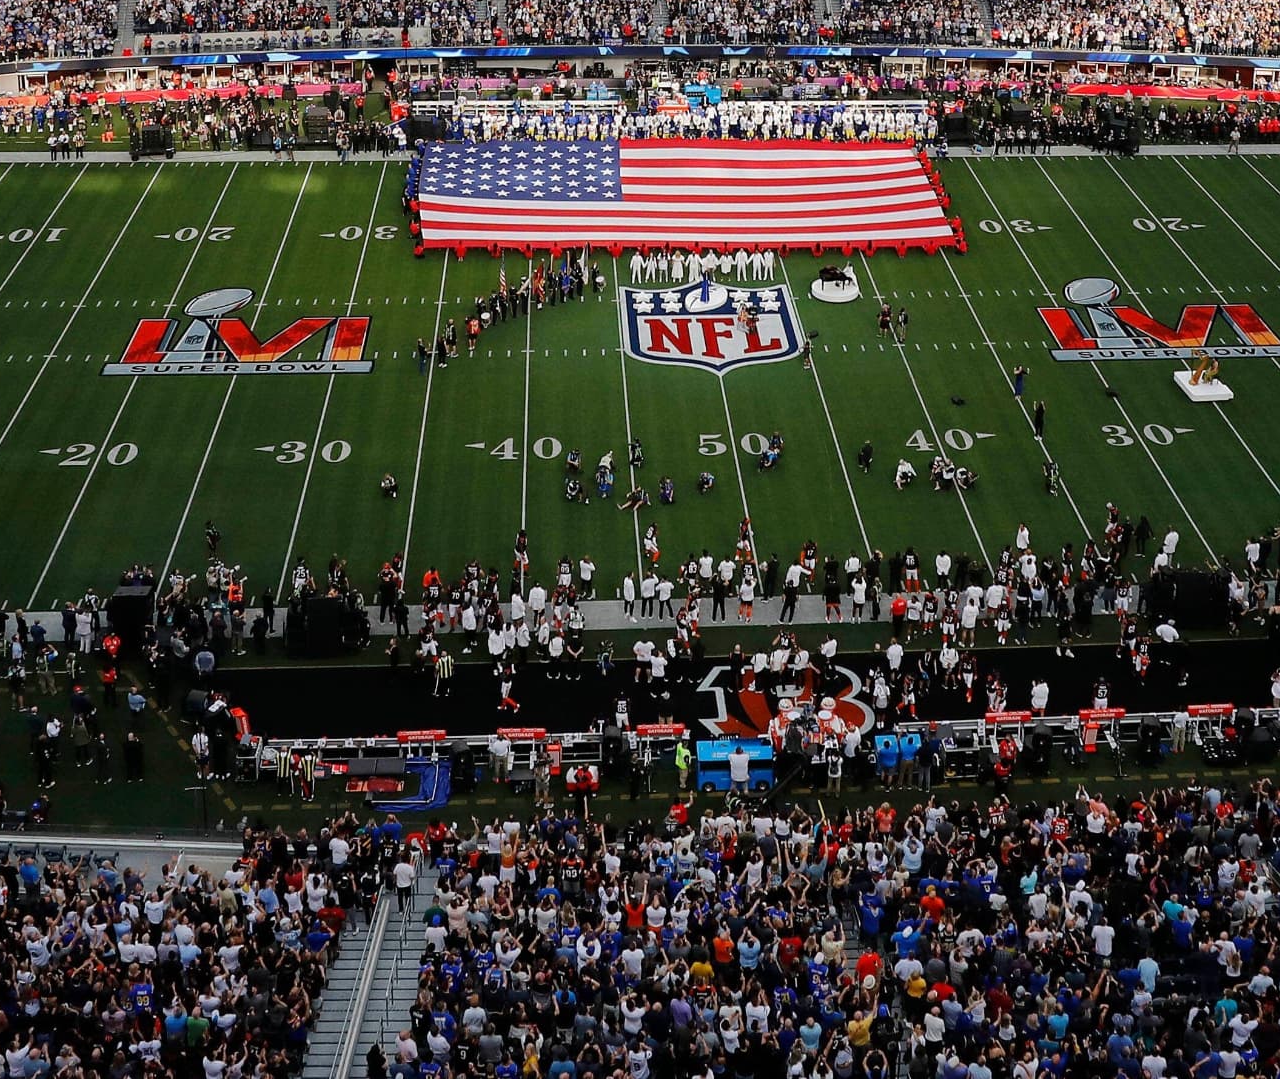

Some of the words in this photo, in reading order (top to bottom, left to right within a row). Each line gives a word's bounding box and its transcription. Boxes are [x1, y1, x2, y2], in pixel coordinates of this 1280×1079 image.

[644, 317, 783, 359] NFL
[1077, 349, 1179, 360] SUPER
[129, 364, 240, 373] SUPER
[255, 363, 346, 373] BOWL
[697, 433, 770, 457] 50
[904, 428, 975, 452] 40
[1101, 423, 1174, 448] 30
[58, 442, 139, 468] 20
[277, 439, 353, 465] 30
[486, 436, 563, 462] 40
